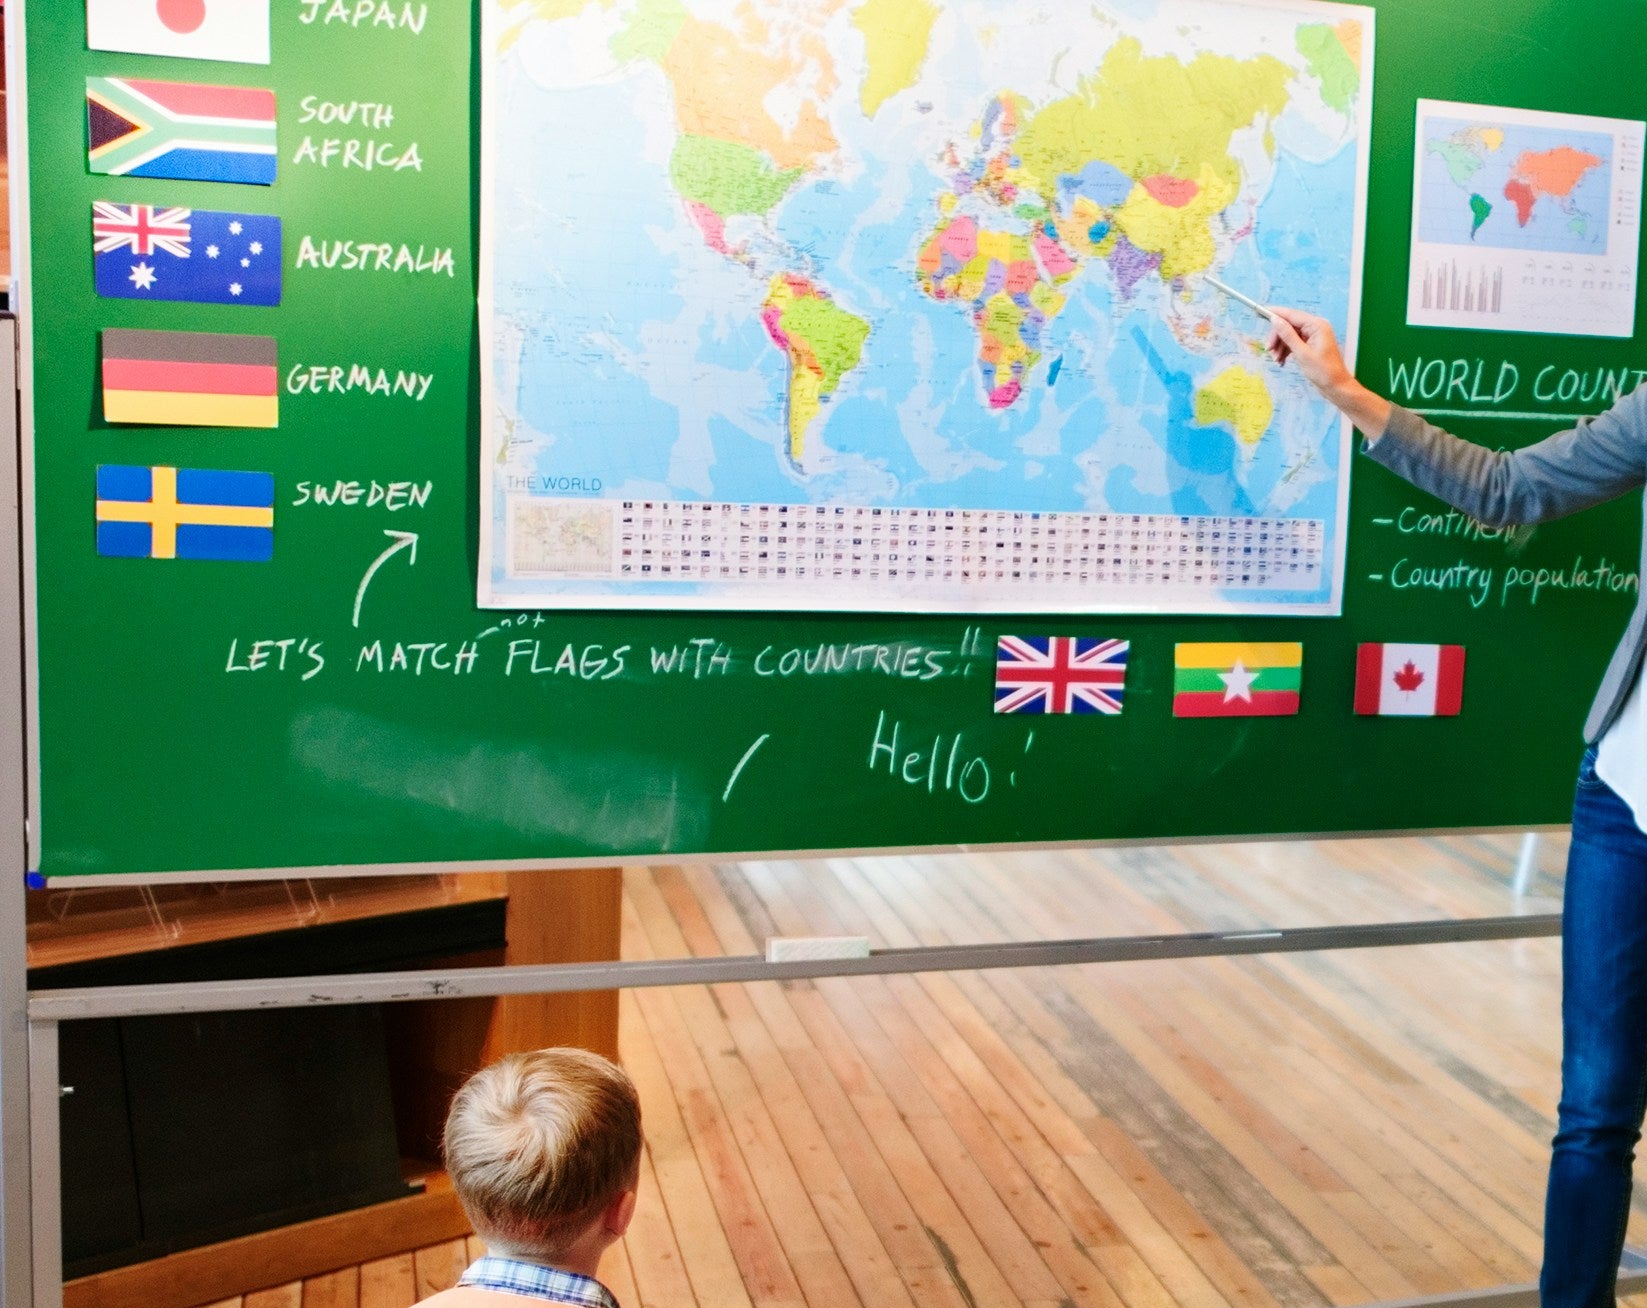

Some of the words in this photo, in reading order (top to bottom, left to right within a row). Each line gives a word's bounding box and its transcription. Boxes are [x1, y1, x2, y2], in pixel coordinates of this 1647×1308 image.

[299, 0, 428, 35] JAPAN
[299, 95, 395, 129] SOUTH
[293, 136, 423, 172] AFRICA
[296, 235, 455, 278] AUSTRALIA
[286, 363, 434, 401] GERMANY
[1388, 356, 1519, 403] WORLD
[292, 480, 433, 511] SWEDEN
[507, 475, 536, 489] THE
[542, 477, 602, 491] WORLD
[1502, 556, 1640, 606] population
[501, 611, 545, 628] not
[225, 638, 325, 681] LET'S
[356, 640, 478, 676] MATCH
[505, 639, 632, 680] FLAGS
[650, 637, 731, 679] WITH
